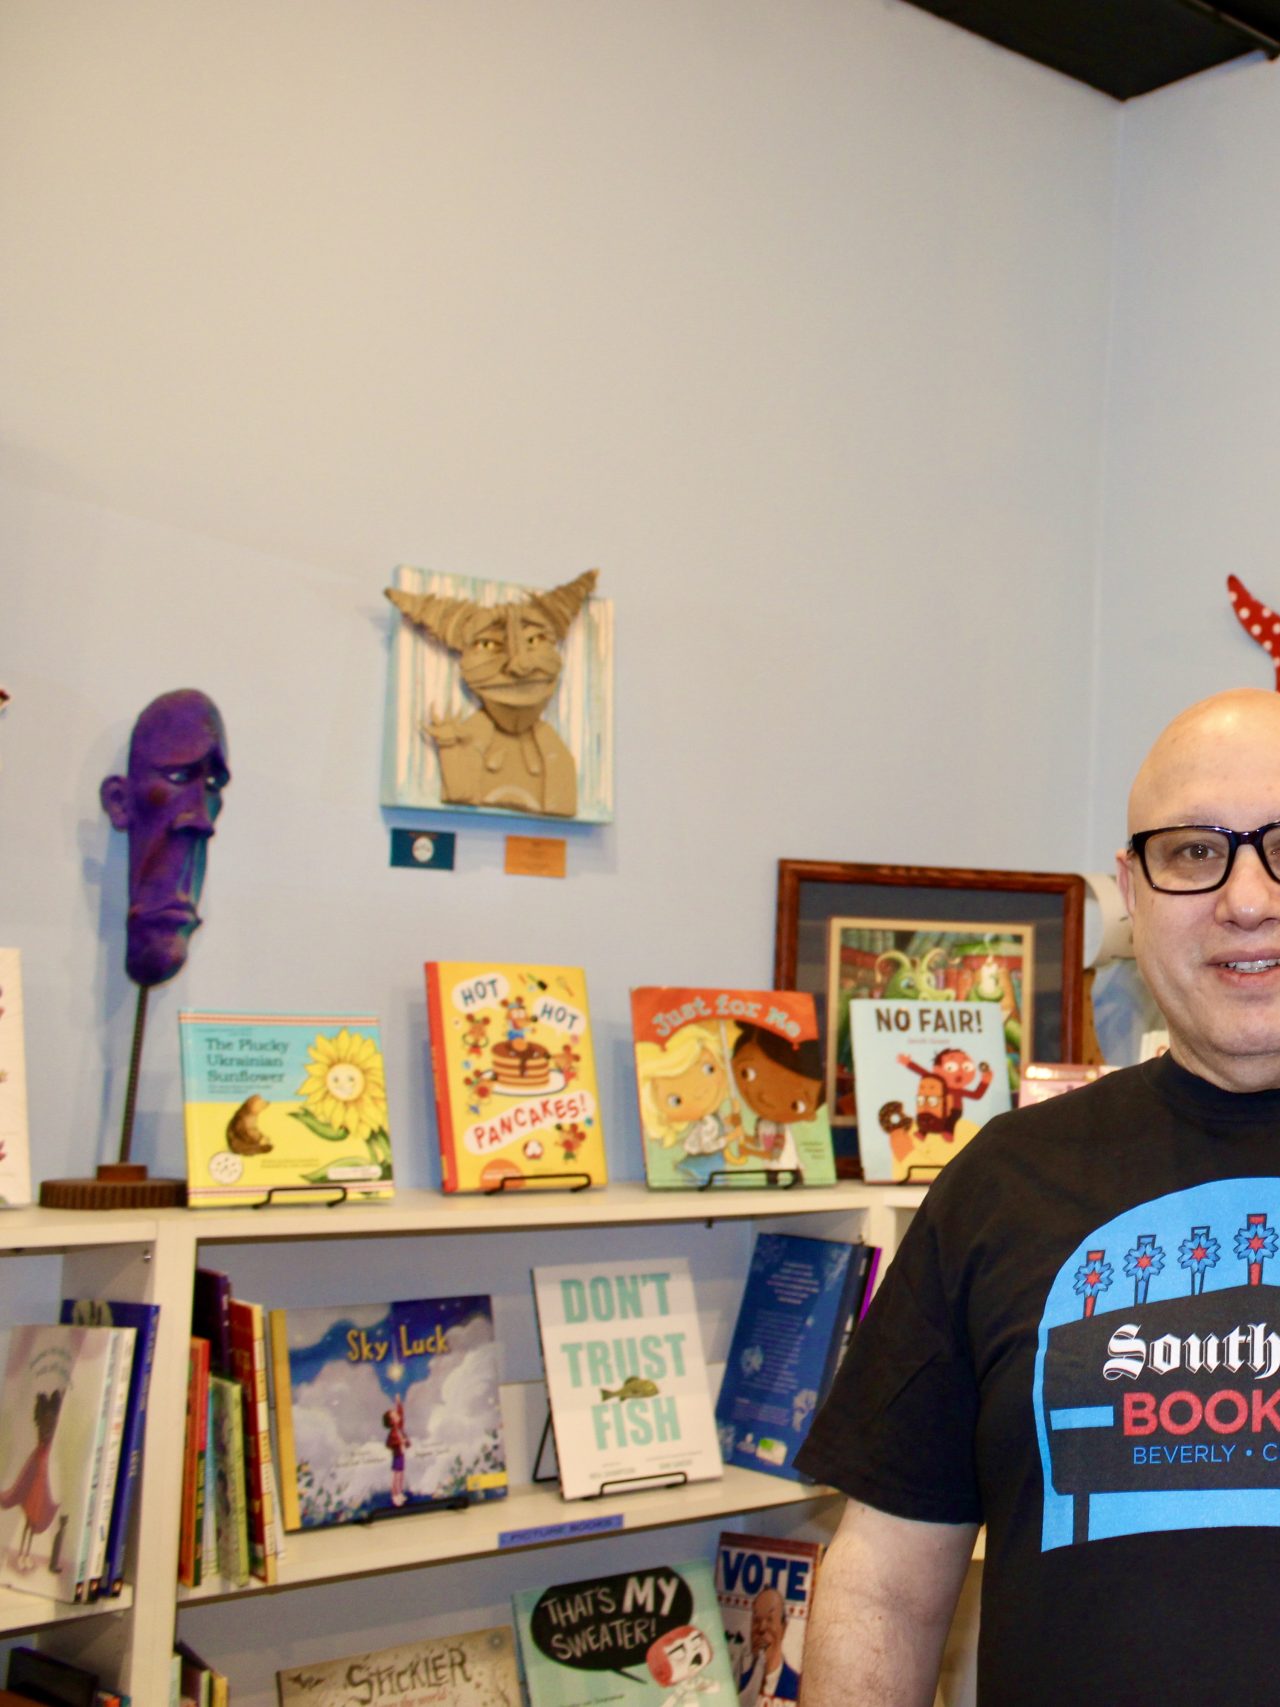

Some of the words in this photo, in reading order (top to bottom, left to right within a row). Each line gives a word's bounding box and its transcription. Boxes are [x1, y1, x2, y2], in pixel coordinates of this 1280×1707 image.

[461, 978, 500, 1006] HOT
[539, 1003, 579, 1031] HOT
[652, 997, 712, 1036] Just
[716, 994, 762, 1018] for
[765, 1007, 800, 1038] Me
[875, 1007, 911, 1033] NO
[918, 1007, 983, 1034] FAIR!
[205, 1038, 233, 1051] The
[238, 1038, 290, 1055] Plucky
[207, 1054, 284, 1068] Ukrainian
[207, 1069, 286, 1083] Sunflower
[474, 1094, 587, 1149] PANCAKES!
[560, 1272, 671, 1326] DON'T
[346, 1329, 389, 1363] Sky
[399, 1325, 450, 1357] Luck
[561, 1333, 687, 1389] TRUST
[591, 1396, 682, 1451] FISH
[1132, 1445, 1237, 1465] BEVERLY
[721, 1550, 811, 1603] VOTE
[540, 1587, 616, 1628] THAT'S
[622, 1576, 679, 1617] MY
[550, 1616, 657, 1661] SWEATER!
[344, 1647, 472, 1705] STICKLER
